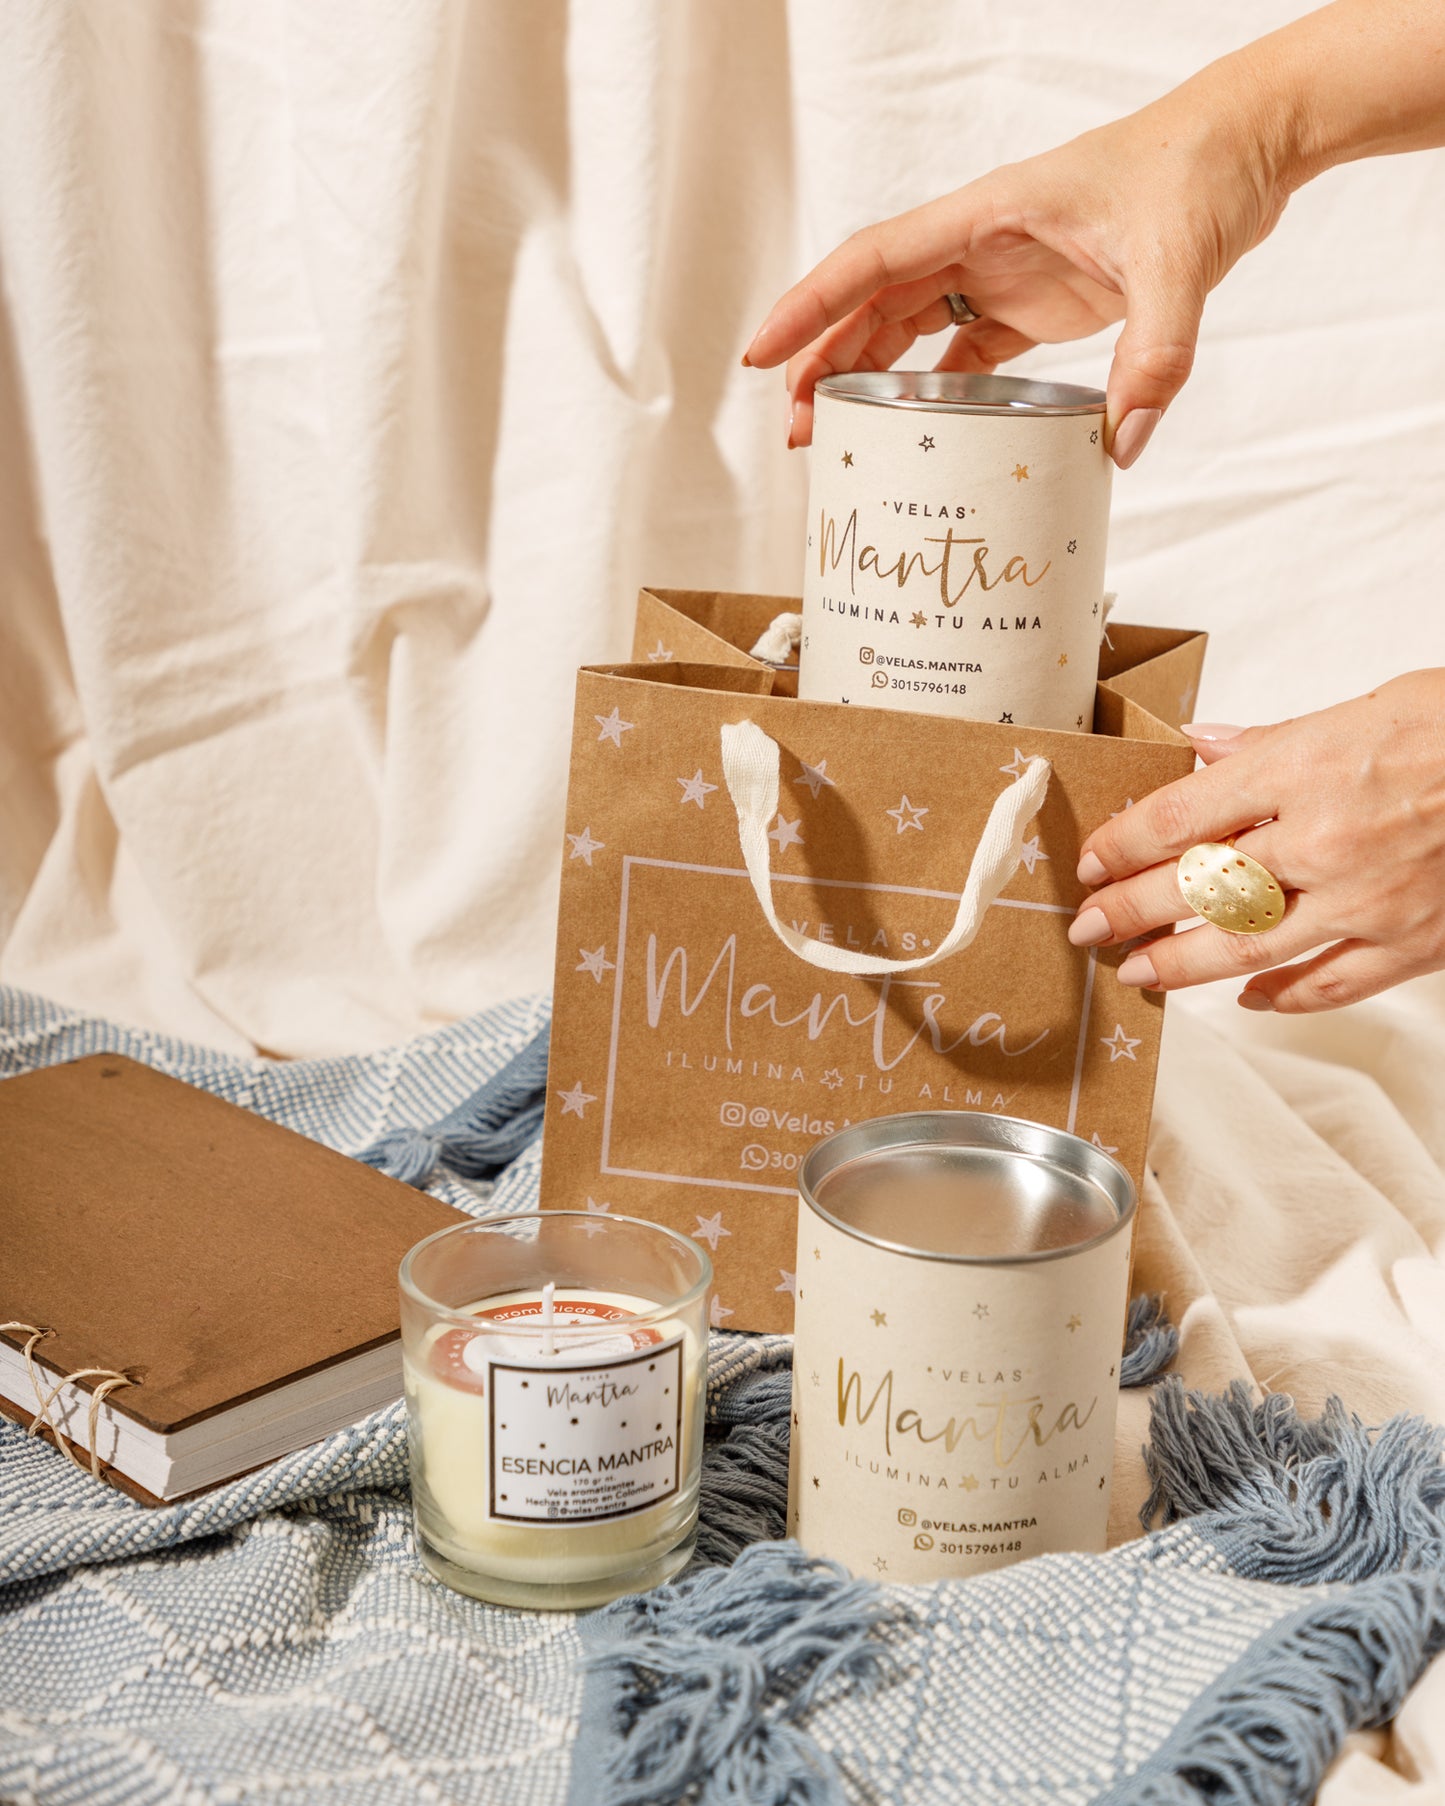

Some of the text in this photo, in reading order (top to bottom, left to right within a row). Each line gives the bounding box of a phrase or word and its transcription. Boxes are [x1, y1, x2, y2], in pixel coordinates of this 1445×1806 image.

[893, 501, 966, 519] VELAS
[820, 508, 1052, 609] Mantra
[823, 597, 1042, 630] ILUMINA TU ALMA
[876, 655, 983, 674] @VELAS.MANTRA
[891, 679, 966, 695] 3015796148
[646, 933, 1050, 1072] Mantra
[666, 1051, 1006, 1108] ILUMINA TU ALMA
[943, 1369, 1022, 1383] VELAS
[547, 1382, 639, 1411] Mantra
[838, 1357, 1098, 1468] Mantra
[502, 1435, 674, 1476] ESENCIA MANTRA
[845, 1451, 1090, 1490] ILUMINA TU ALMA
[525, 1497, 560, 1506] Hechas
[572, 1497, 599, 1505] mano
[602, 1494, 612, 1502] en
[615, 1482, 655, 1499] Colombia
[547, 1480, 635, 1497] Vela aromatizantes
[560, 1500, 627, 1515] @velas.mantra
[921, 1517, 1038, 1533] @VELAS.MANTRA
[940, 1541, 1022, 1554] 3015796148
